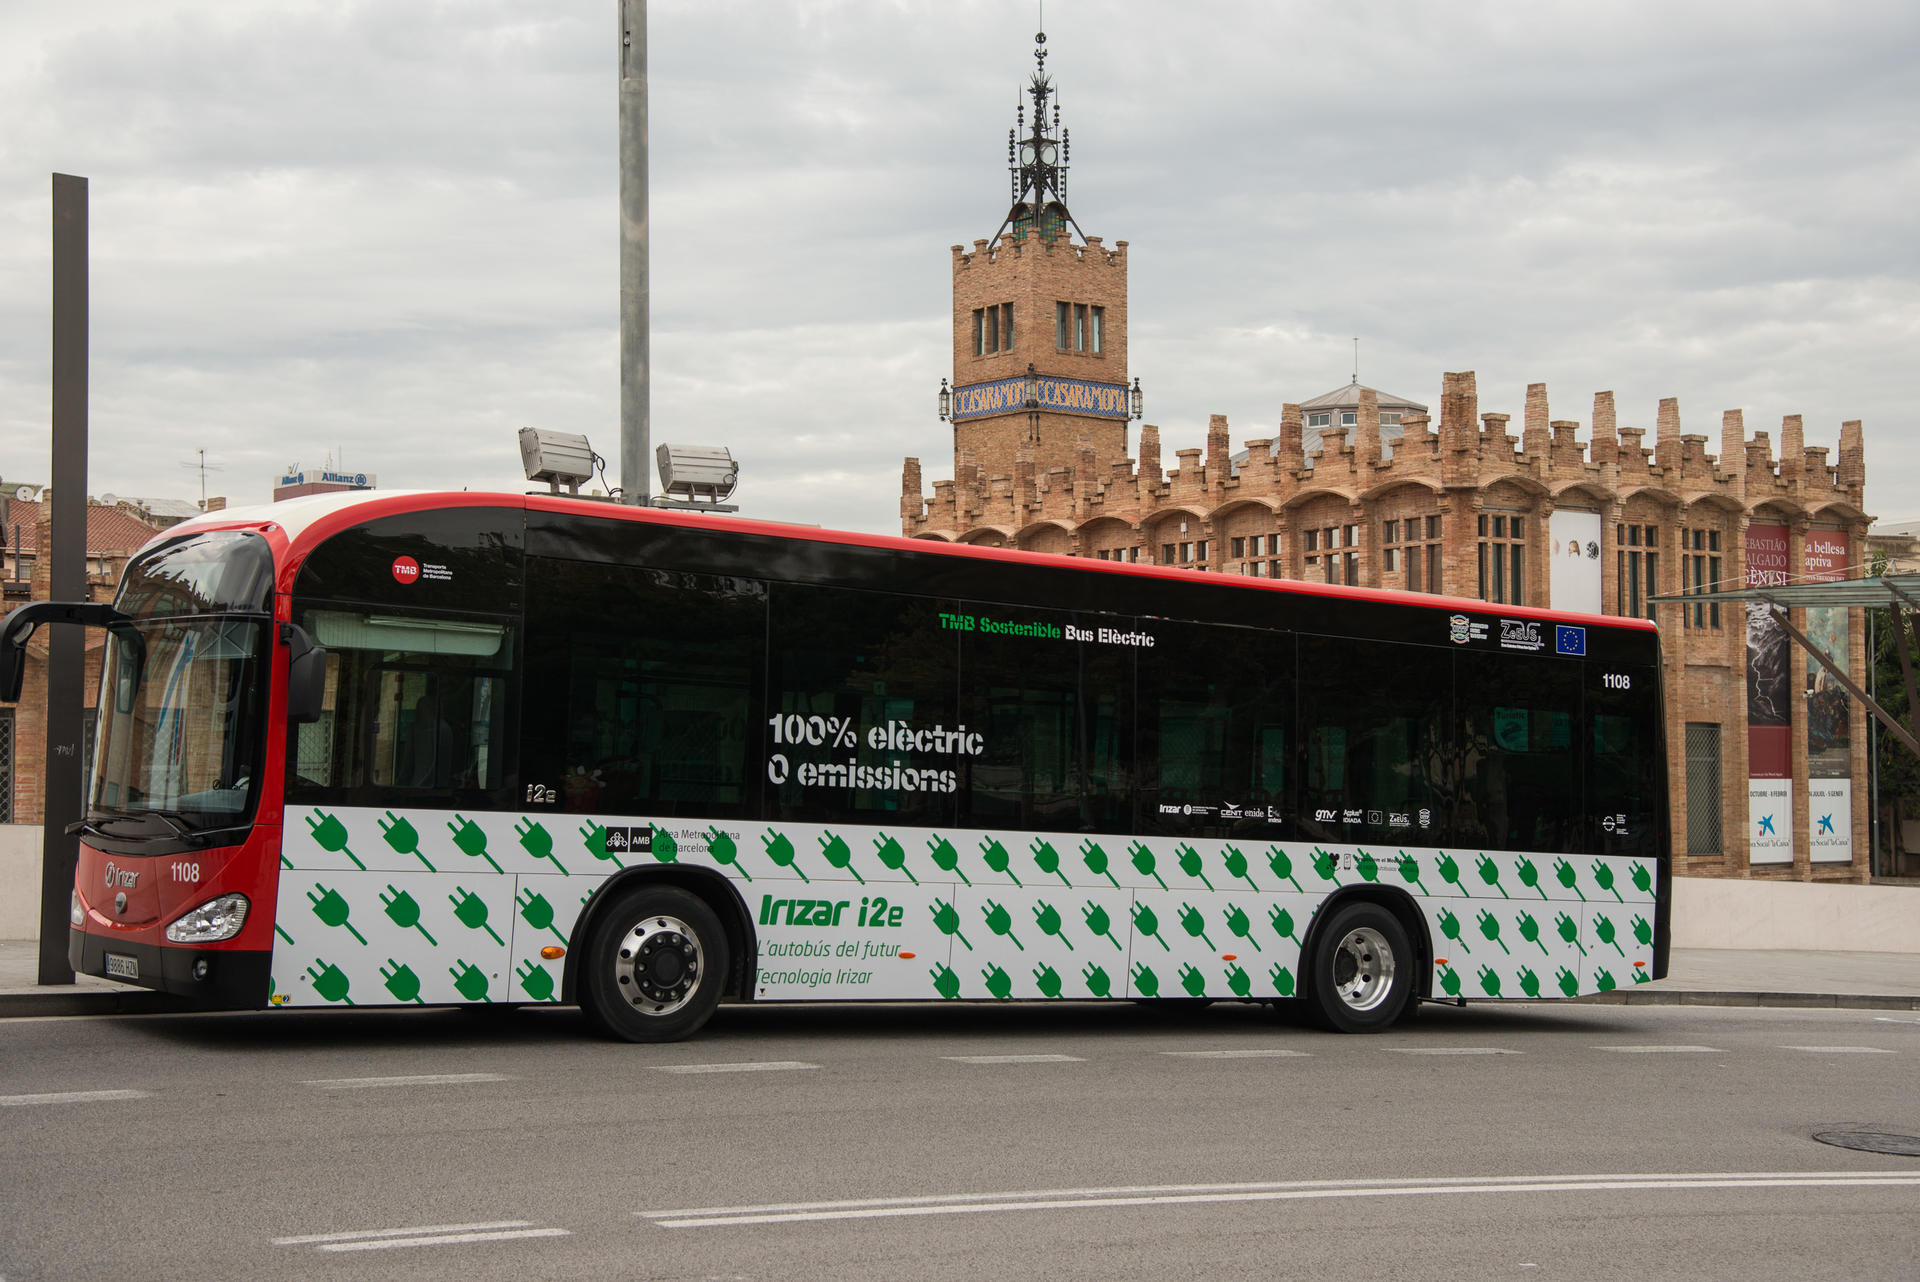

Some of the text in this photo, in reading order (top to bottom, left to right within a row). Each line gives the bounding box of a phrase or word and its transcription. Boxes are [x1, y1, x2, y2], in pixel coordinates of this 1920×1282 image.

[322, 472, 354, 483] Allianz
[1745, 537, 1787, 552] EBASTIÃO
[1805, 541, 1845, 555] a bellesa
[1746, 553, 1787, 567] ALGADO
[1805, 554, 1832, 571] aptiva
[395, 565, 417, 575] TMB
[938, 613, 1155, 648] TMB Sostenible Bus Elèctric
[1602, 673, 1631, 689] 1108
[768, 713, 984, 755] 100% elèctric
[768, 753, 957, 793] 0 emissions
[1244, 807, 1264, 818] enide
[632, 836, 650, 845] AMB
[681, 829, 740, 840] Metropolitana
[659, 843, 714, 854] de Barcelona
[171, 861, 200, 883] 1108
[759, 894, 904, 928] Irizar i2e
[756, 939, 901, 961] L'autobús del futur
[755, 967, 873, 988] Tecnologia Irizar
